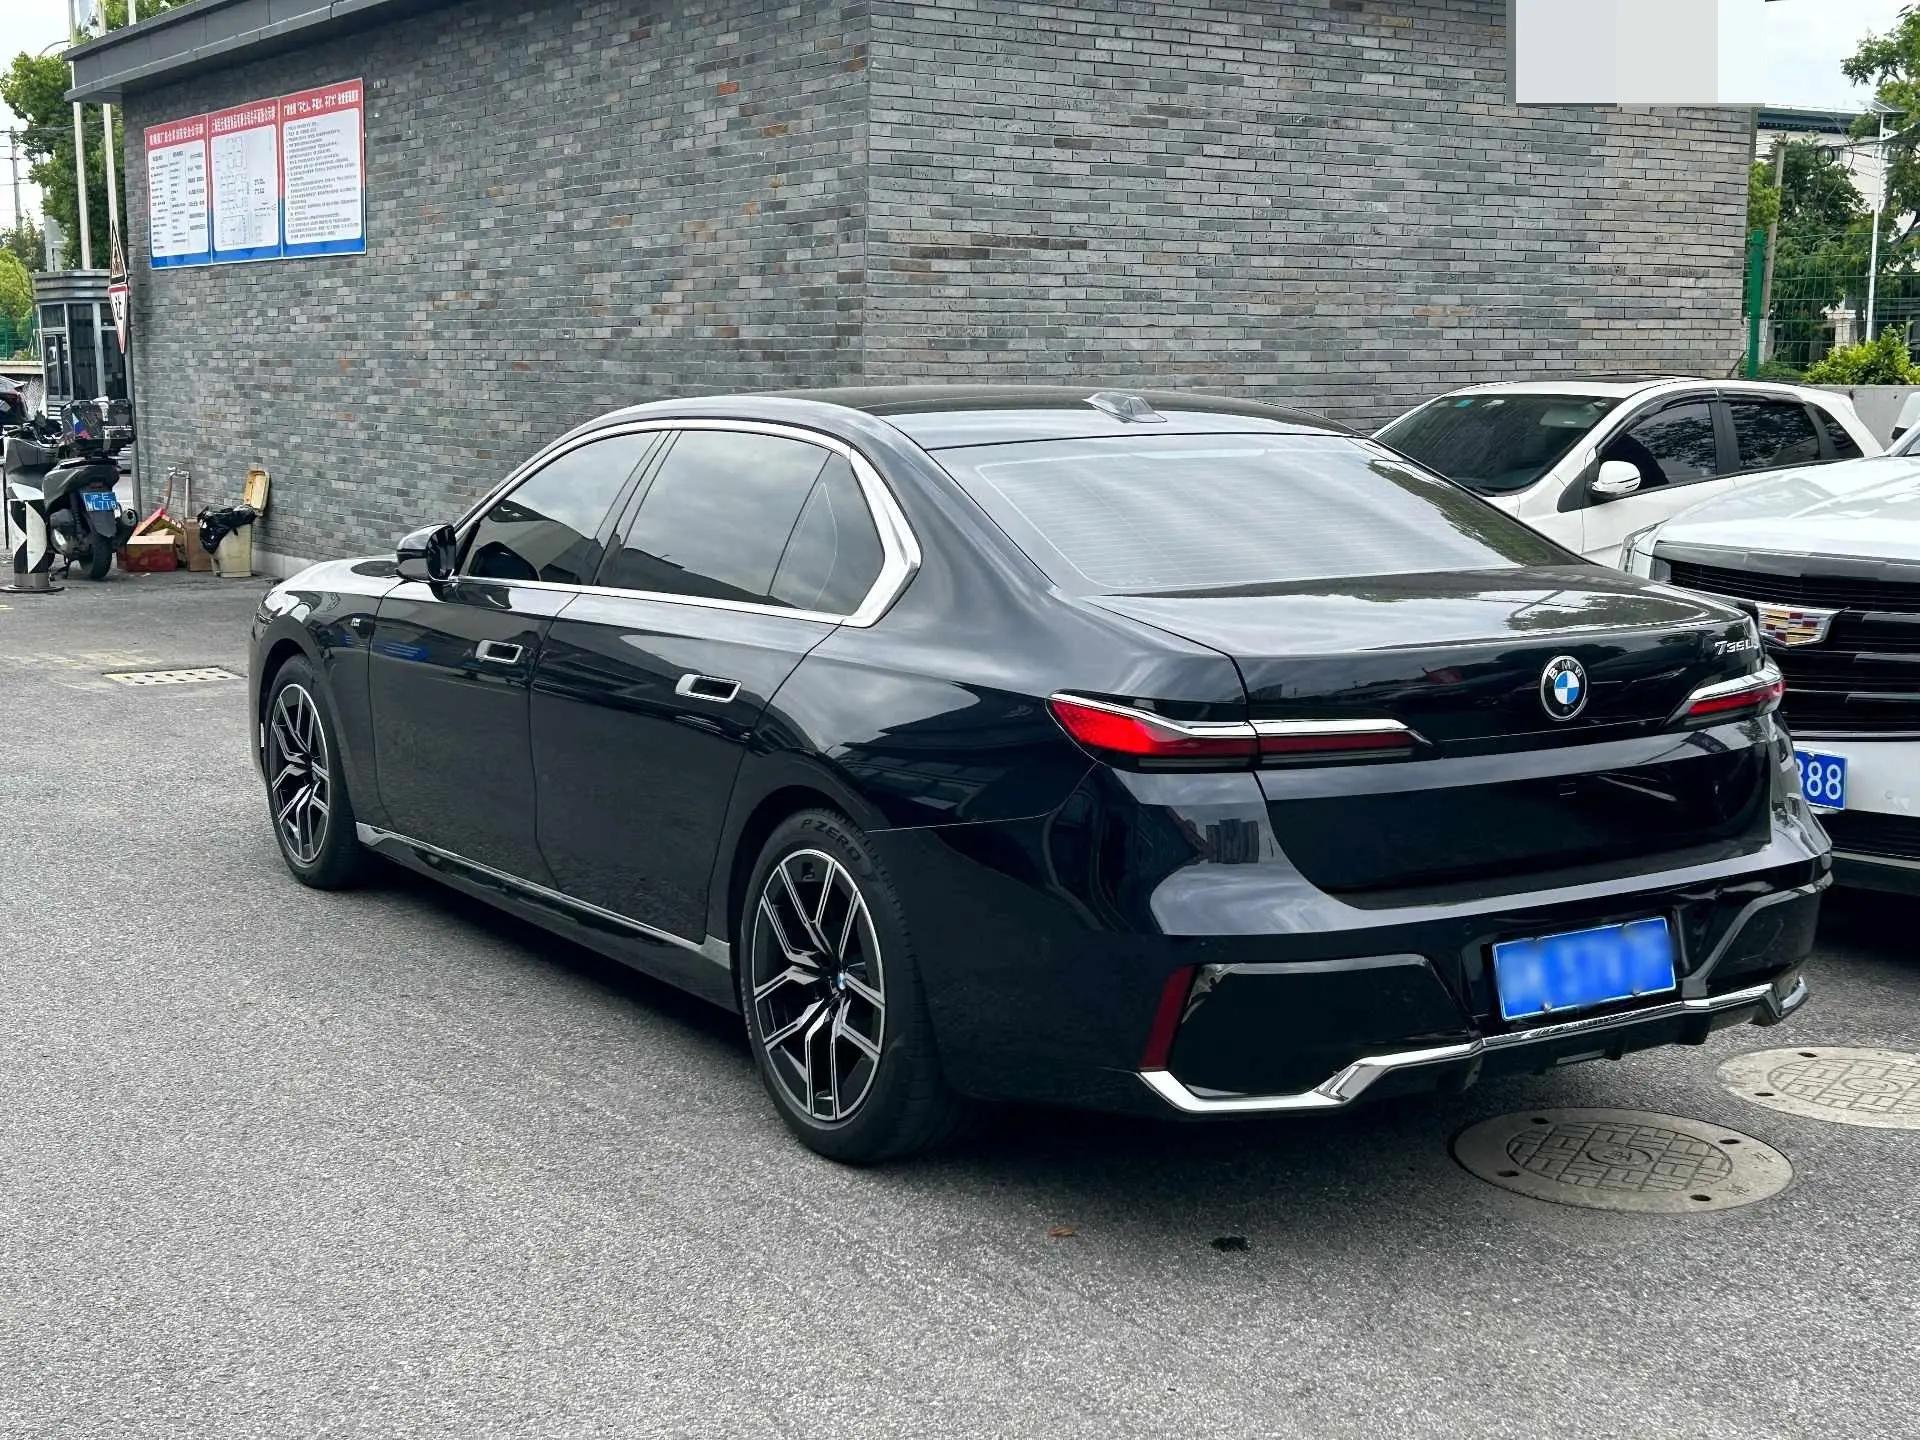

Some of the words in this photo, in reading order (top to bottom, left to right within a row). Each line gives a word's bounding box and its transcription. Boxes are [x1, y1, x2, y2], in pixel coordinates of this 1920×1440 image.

[114, 295, 123, 320] 让
[801, 818, 813, 830] P
[815, 820, 861, 861] ZERO
